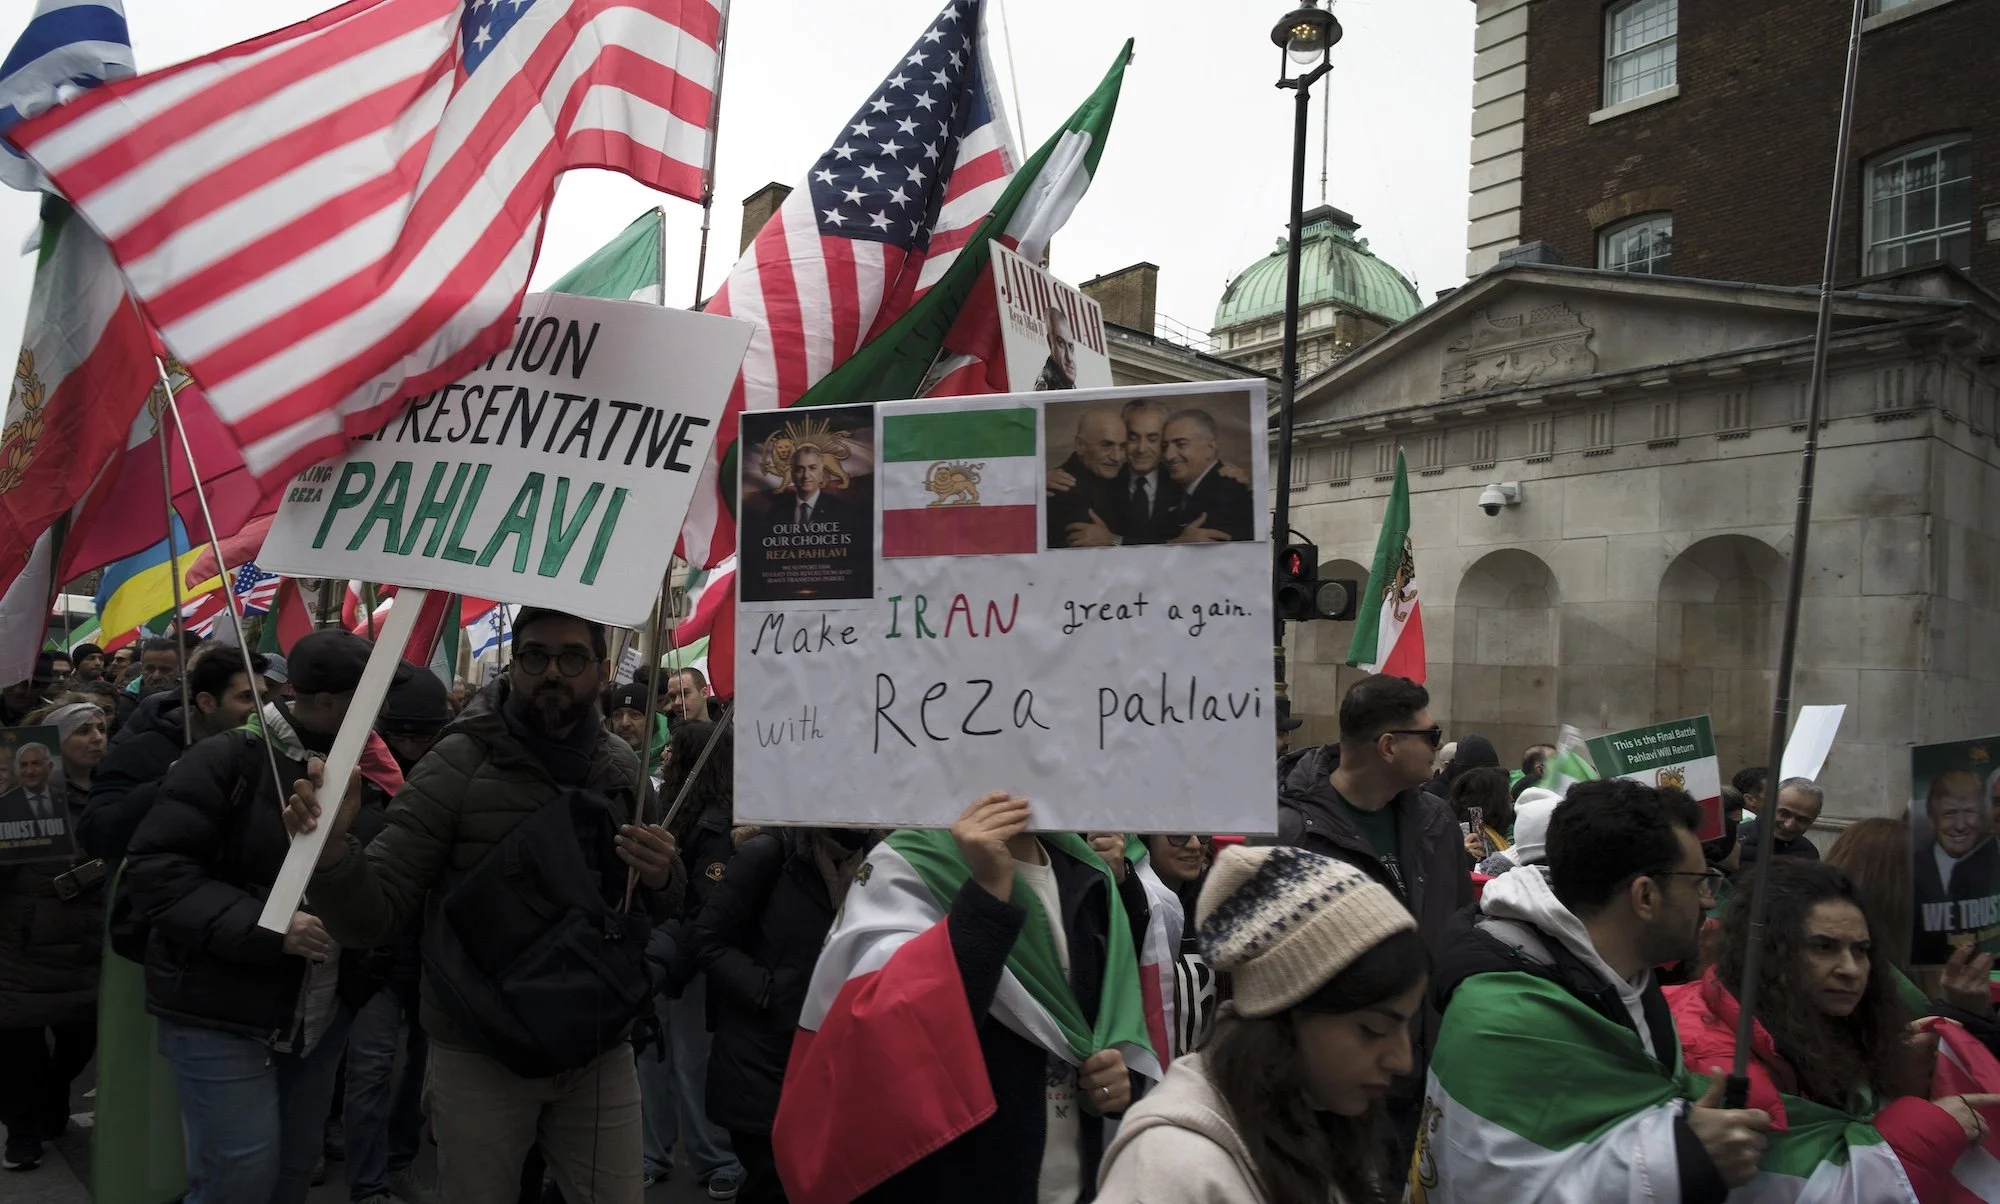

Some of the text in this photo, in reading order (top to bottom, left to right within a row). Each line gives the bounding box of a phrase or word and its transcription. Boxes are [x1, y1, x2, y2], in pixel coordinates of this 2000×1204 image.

[1053, 282, 1105, 356] SHAH
[356, 384, 710, 473] RESENTATIVE
[288, 487, 323, 503] REZA
[312, 461, 628, 586] PAHLAVI
[773, 521, 840, 535] OUR VOICE
[762, 533, 852, 548] OUR CHOICE IS
[766, 547, 848, 561] REZA PAHLAVI
[751, 612, 859, 655] Make
[885, 593, 1020, 639] IRAN
[1062, 593, 1148, 635] great
[756, 672, 1261, 754] with Reza pahlavi
[1613, 740, 1634, 751] This
[1642, 735, 1657, 745] the
[1656, 730, 1675, 743] Final
[1676, 727, 1696, 740] Battle
[1627, 743, 1695, 764] Pahlavi Will Return
[0, 818, 65, 840] TRUST YOU
[1922, 894, 2000, 931] WE TRUS
